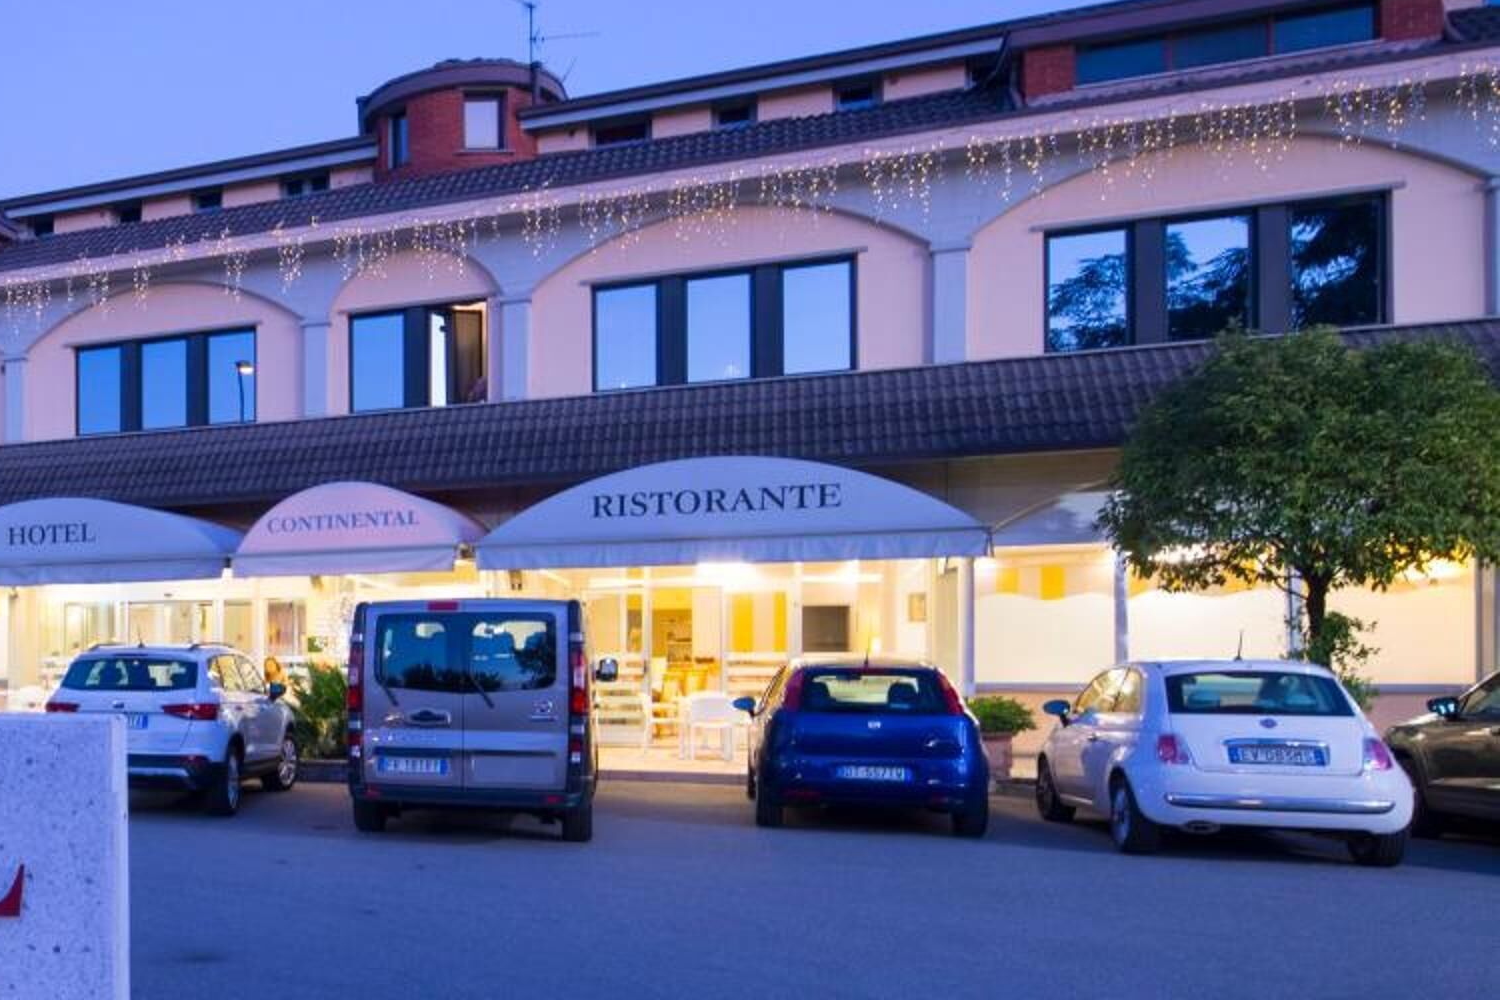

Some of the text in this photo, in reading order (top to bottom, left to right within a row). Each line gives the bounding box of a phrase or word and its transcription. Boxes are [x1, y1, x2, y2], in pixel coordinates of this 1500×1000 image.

[592, 483, 842, 518] RISTORANTE
[268, 510, 419, 534] CONTINENTAL
[8, 523, 96, 546] HOTEL
